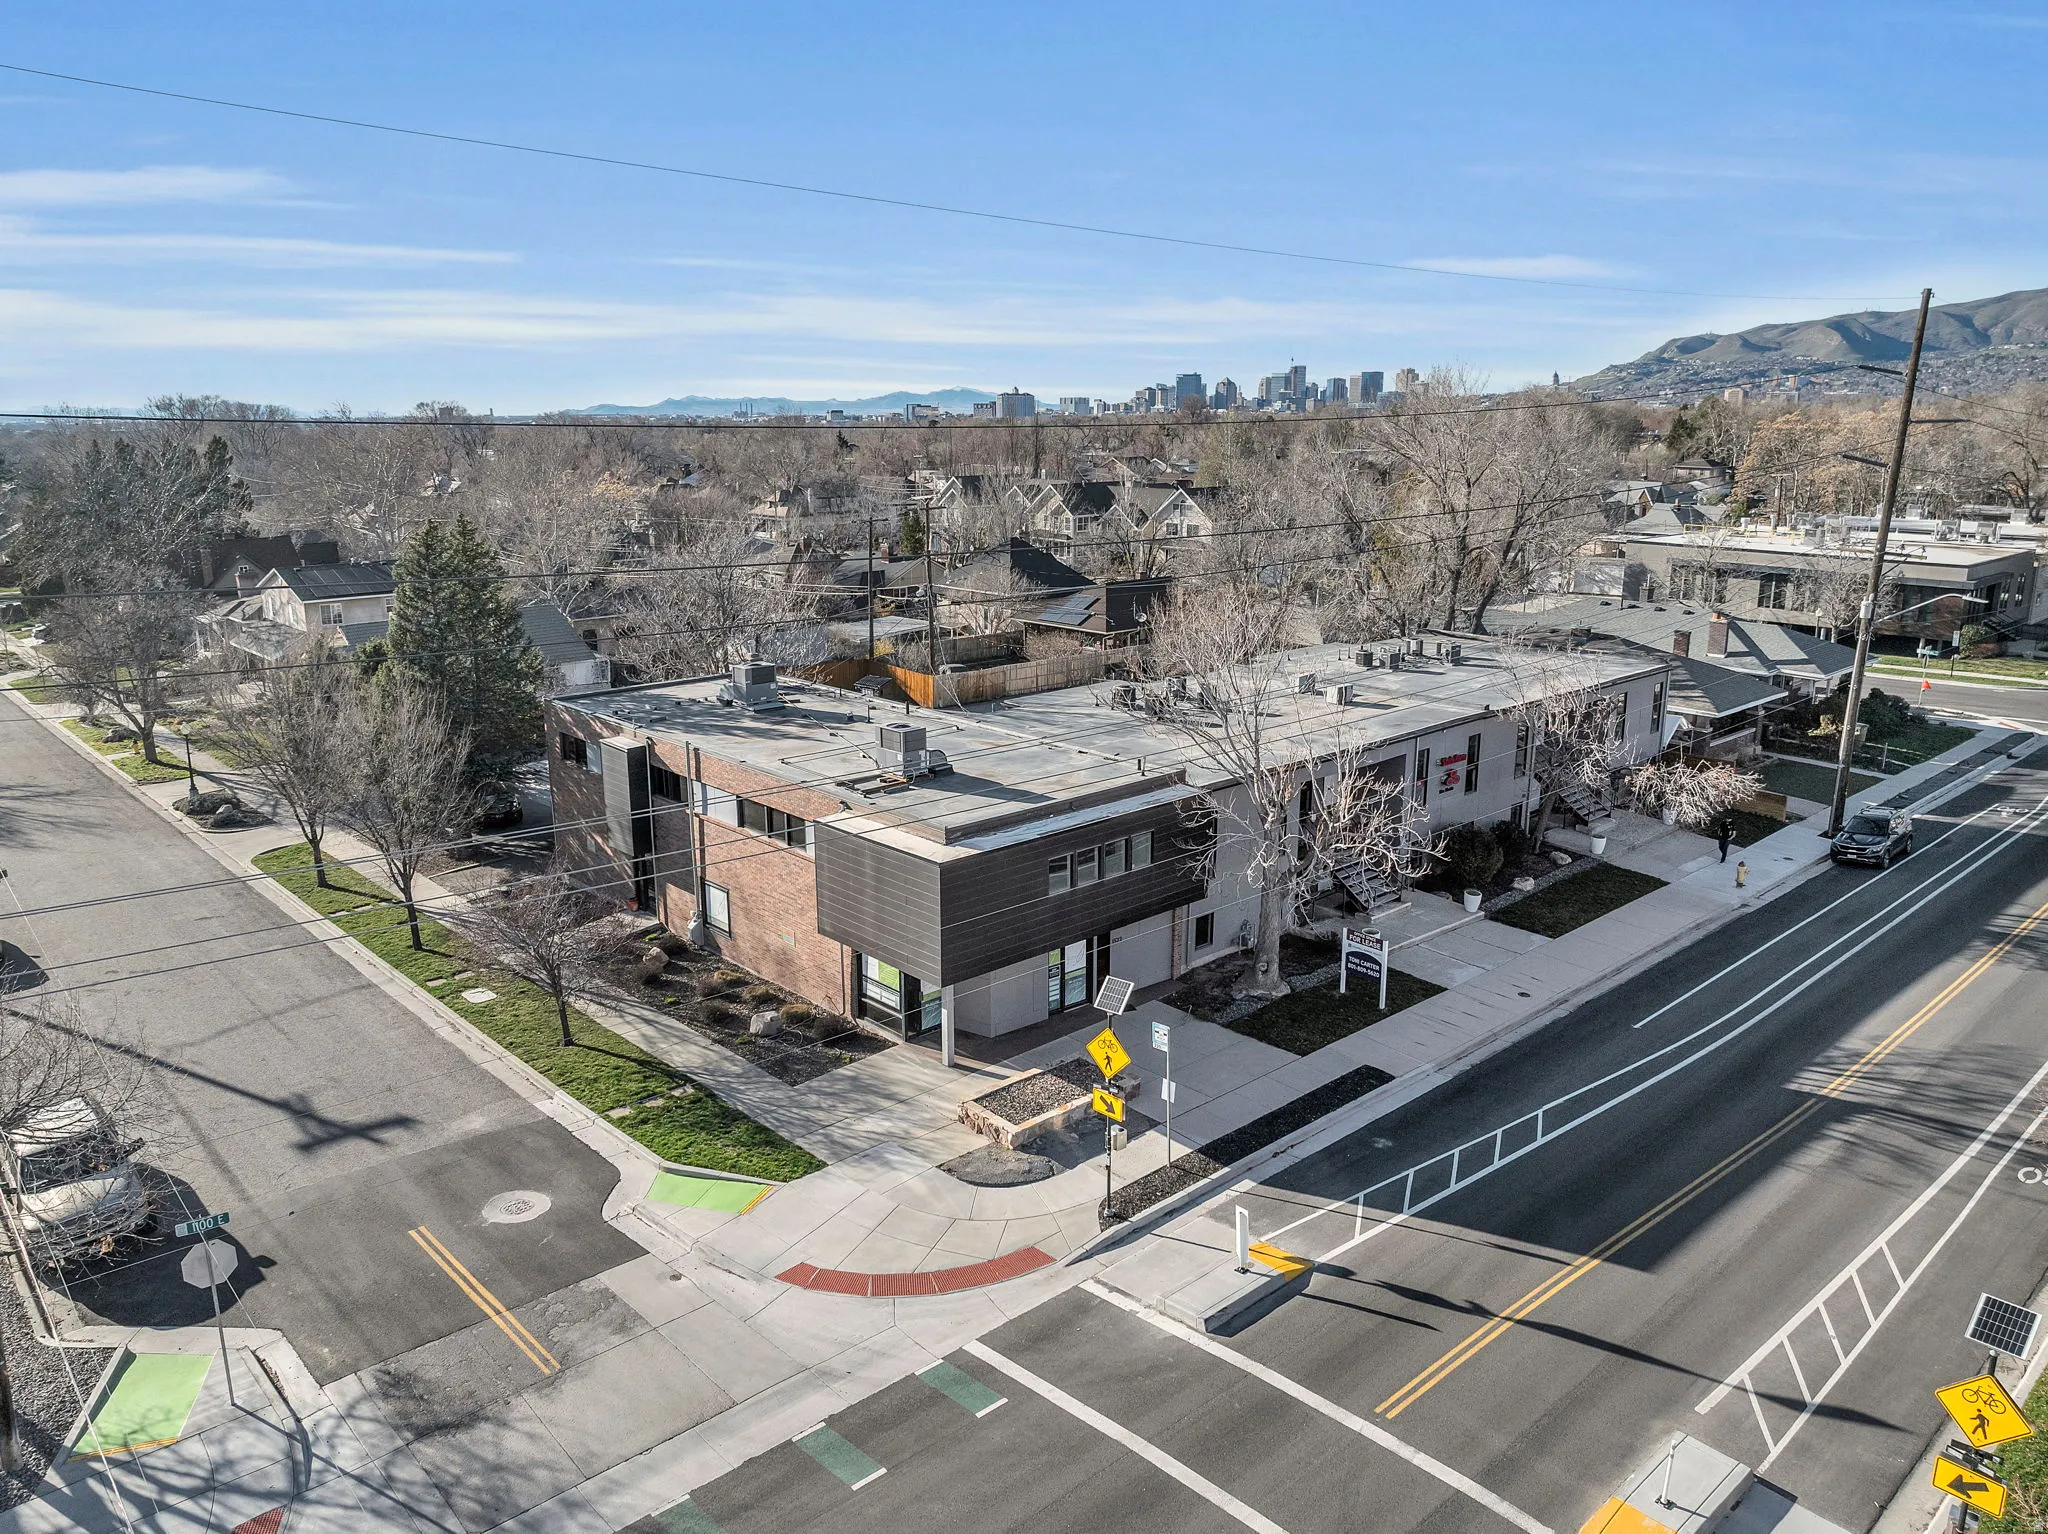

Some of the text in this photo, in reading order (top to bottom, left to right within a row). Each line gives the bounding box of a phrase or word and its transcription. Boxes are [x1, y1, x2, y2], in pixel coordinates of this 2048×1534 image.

[1349, 934, 1381, 950] FOR LEASE
[1360, 960, 1380, 971] CARTER
[192, 1218, 214, 1232] 1100
[217, 1214, 225, 1225] E
